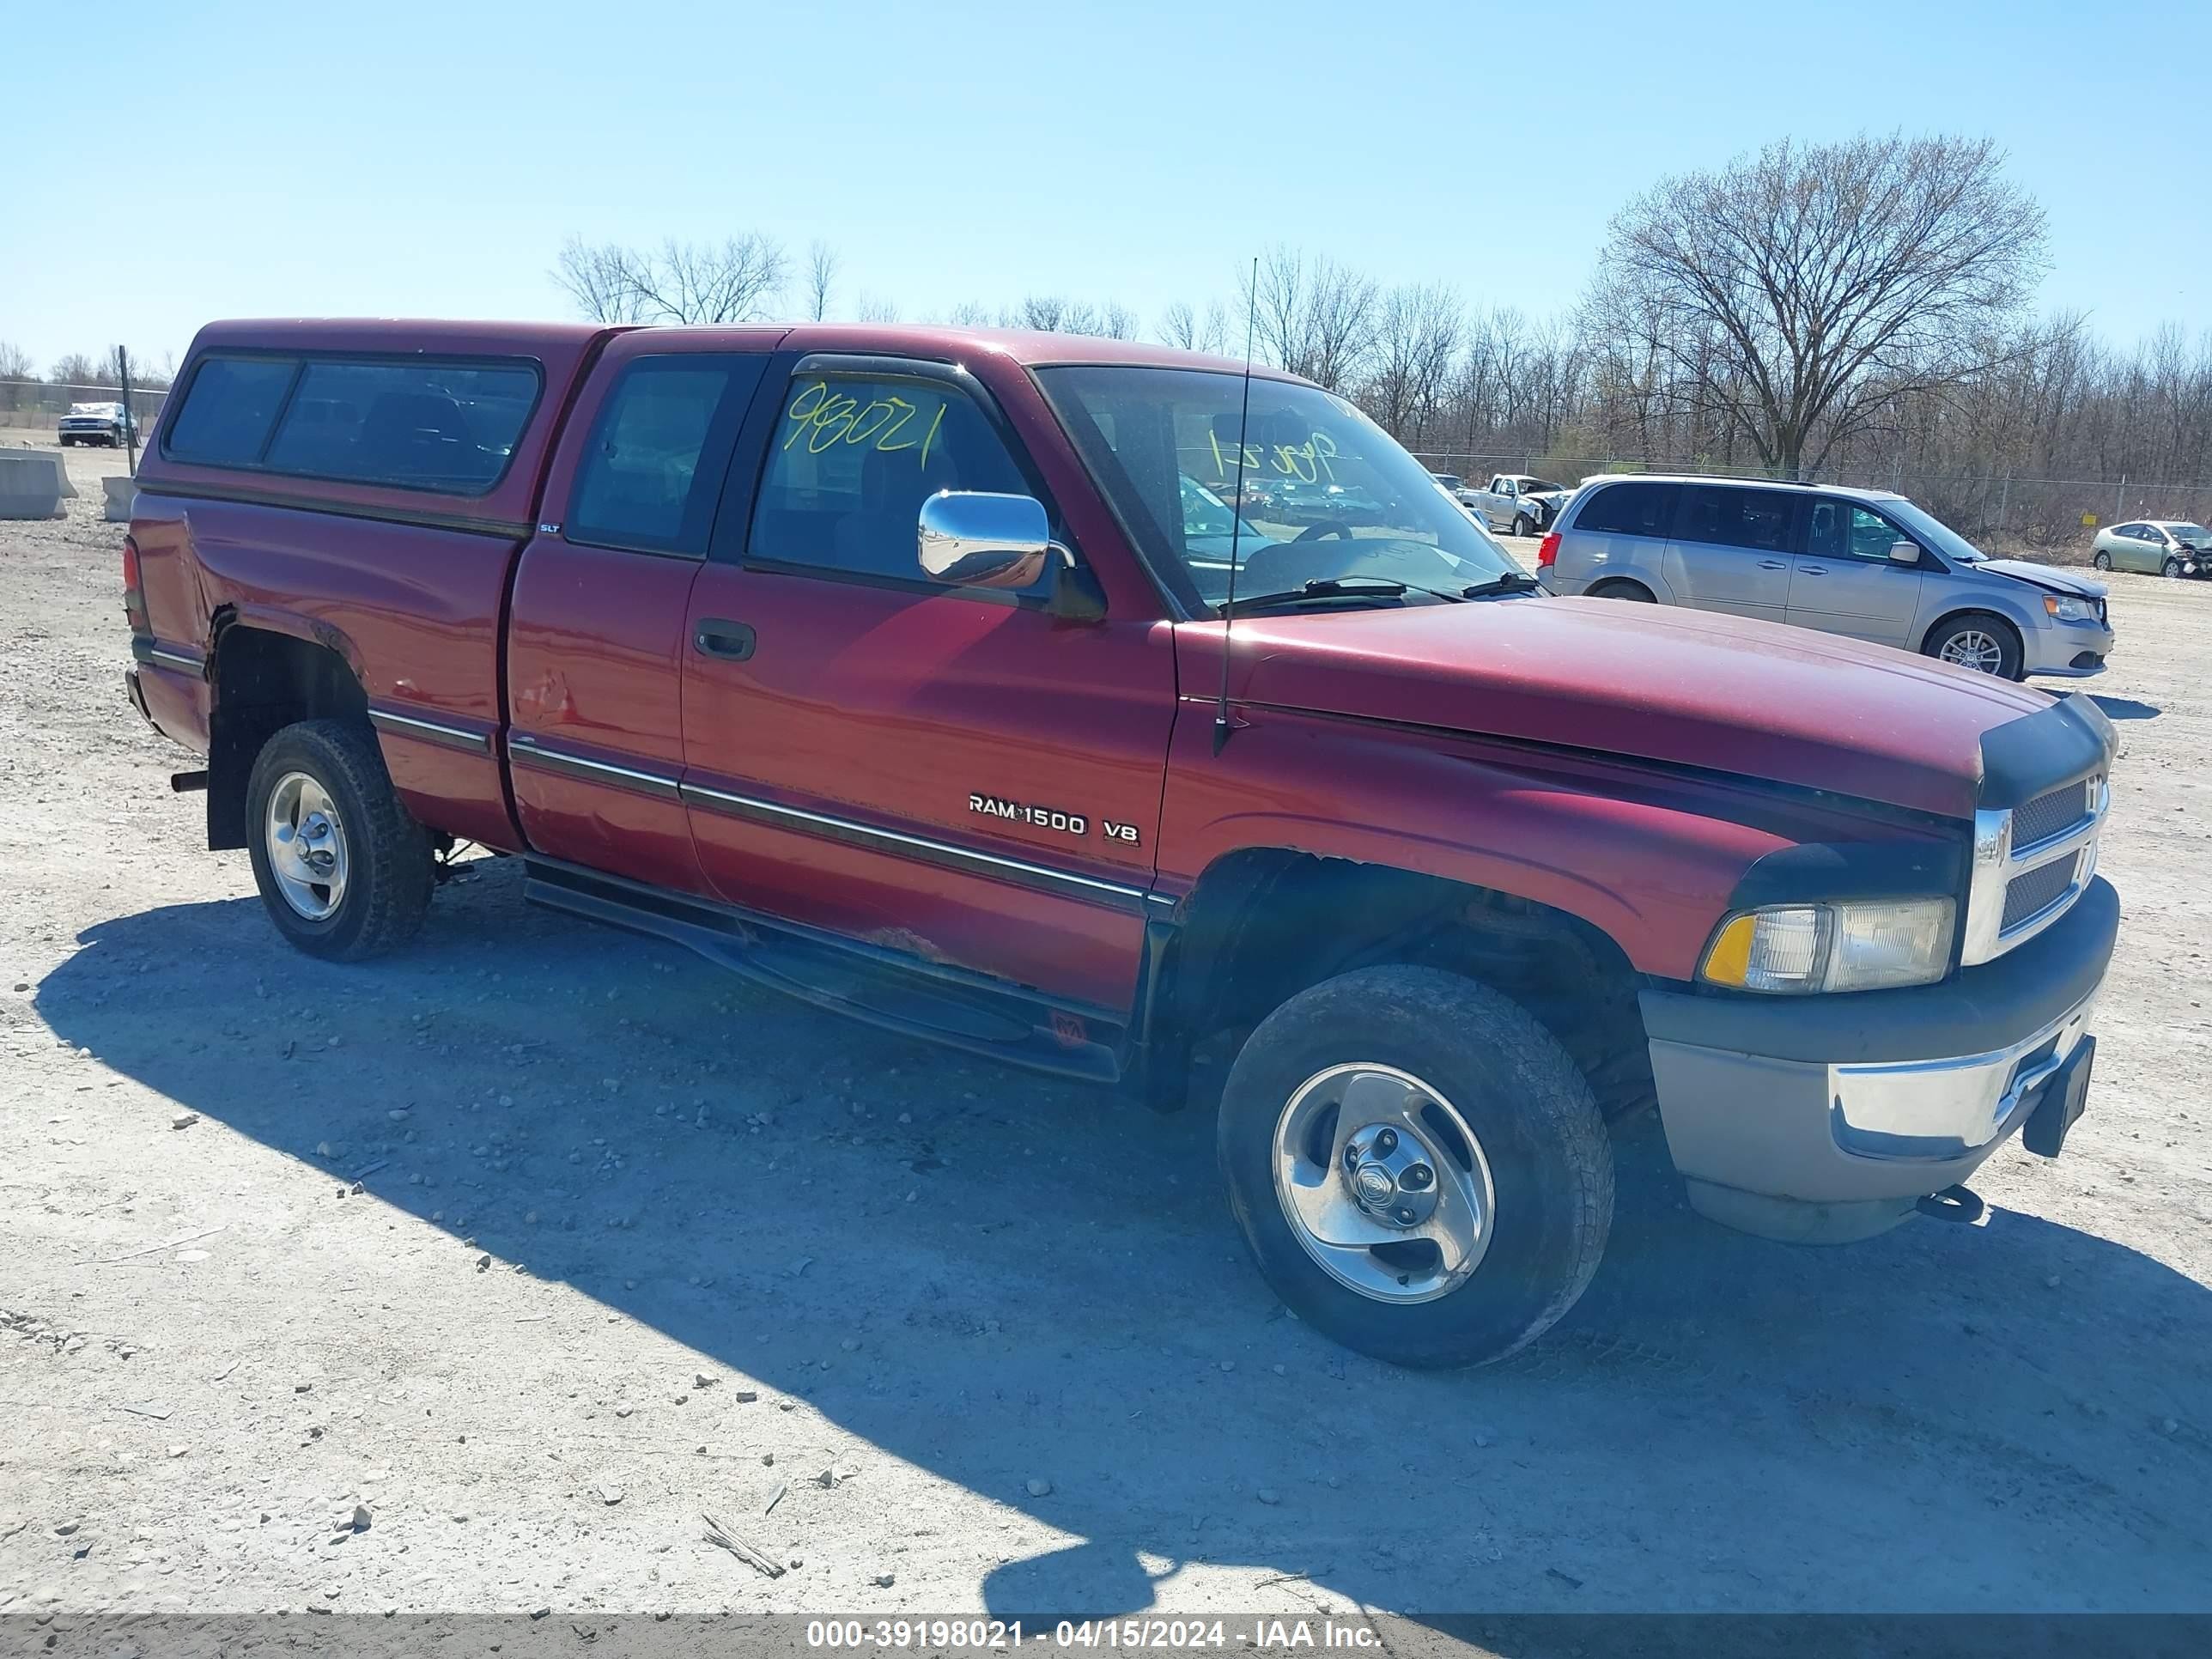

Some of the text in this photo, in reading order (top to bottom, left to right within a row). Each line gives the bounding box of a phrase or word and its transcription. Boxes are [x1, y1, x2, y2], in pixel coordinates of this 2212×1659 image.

[784, 381, 947, 472] 98021
[540, 524, 560, 532] SLT
[969, 795, 1015, 820] RAM
[1025, 806, 1085, 834] 1500
[1103, 821, 1138, 841] V8
